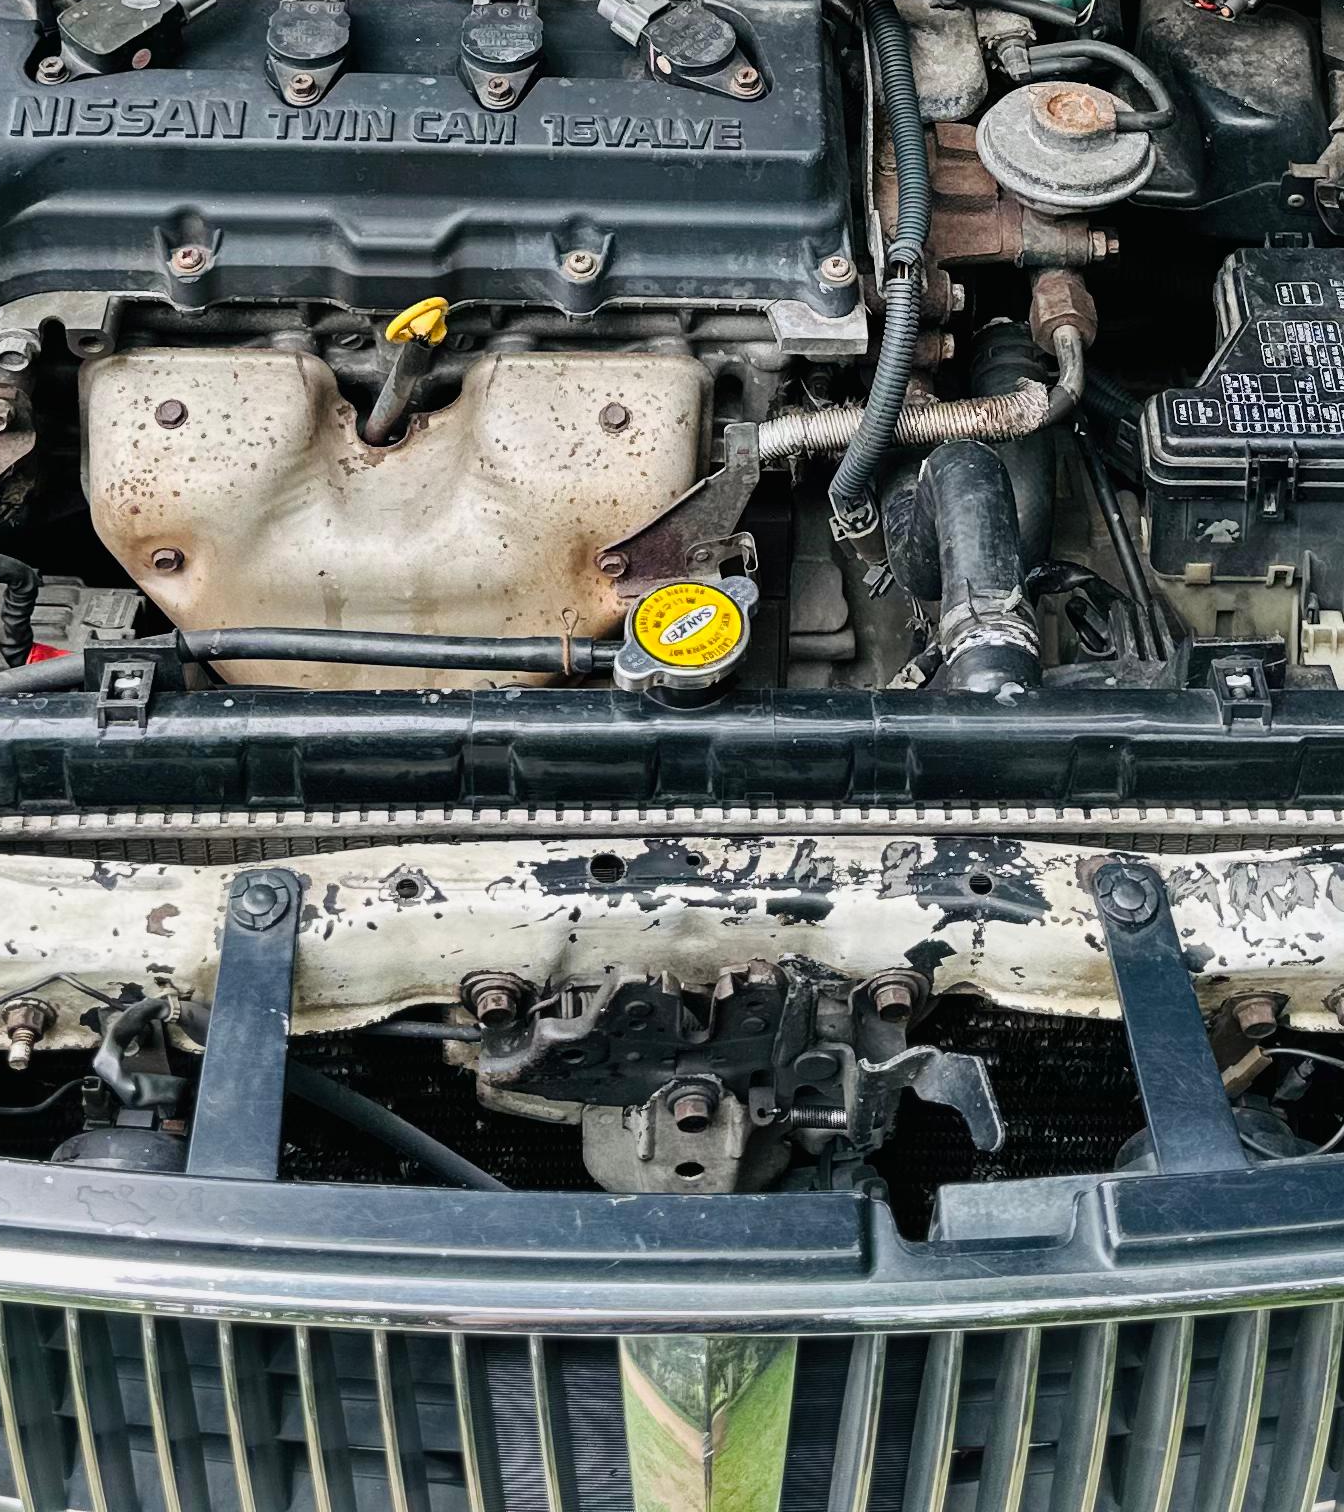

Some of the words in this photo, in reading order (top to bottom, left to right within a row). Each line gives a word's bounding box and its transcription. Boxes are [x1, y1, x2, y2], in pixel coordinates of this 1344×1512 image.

[9, 96, 248, 139] NISSAN
[268, 107, 395, 142] TWIN
[412, 111, 517, 146] CAM
[542, 115, 744, 150] 16VALVE
